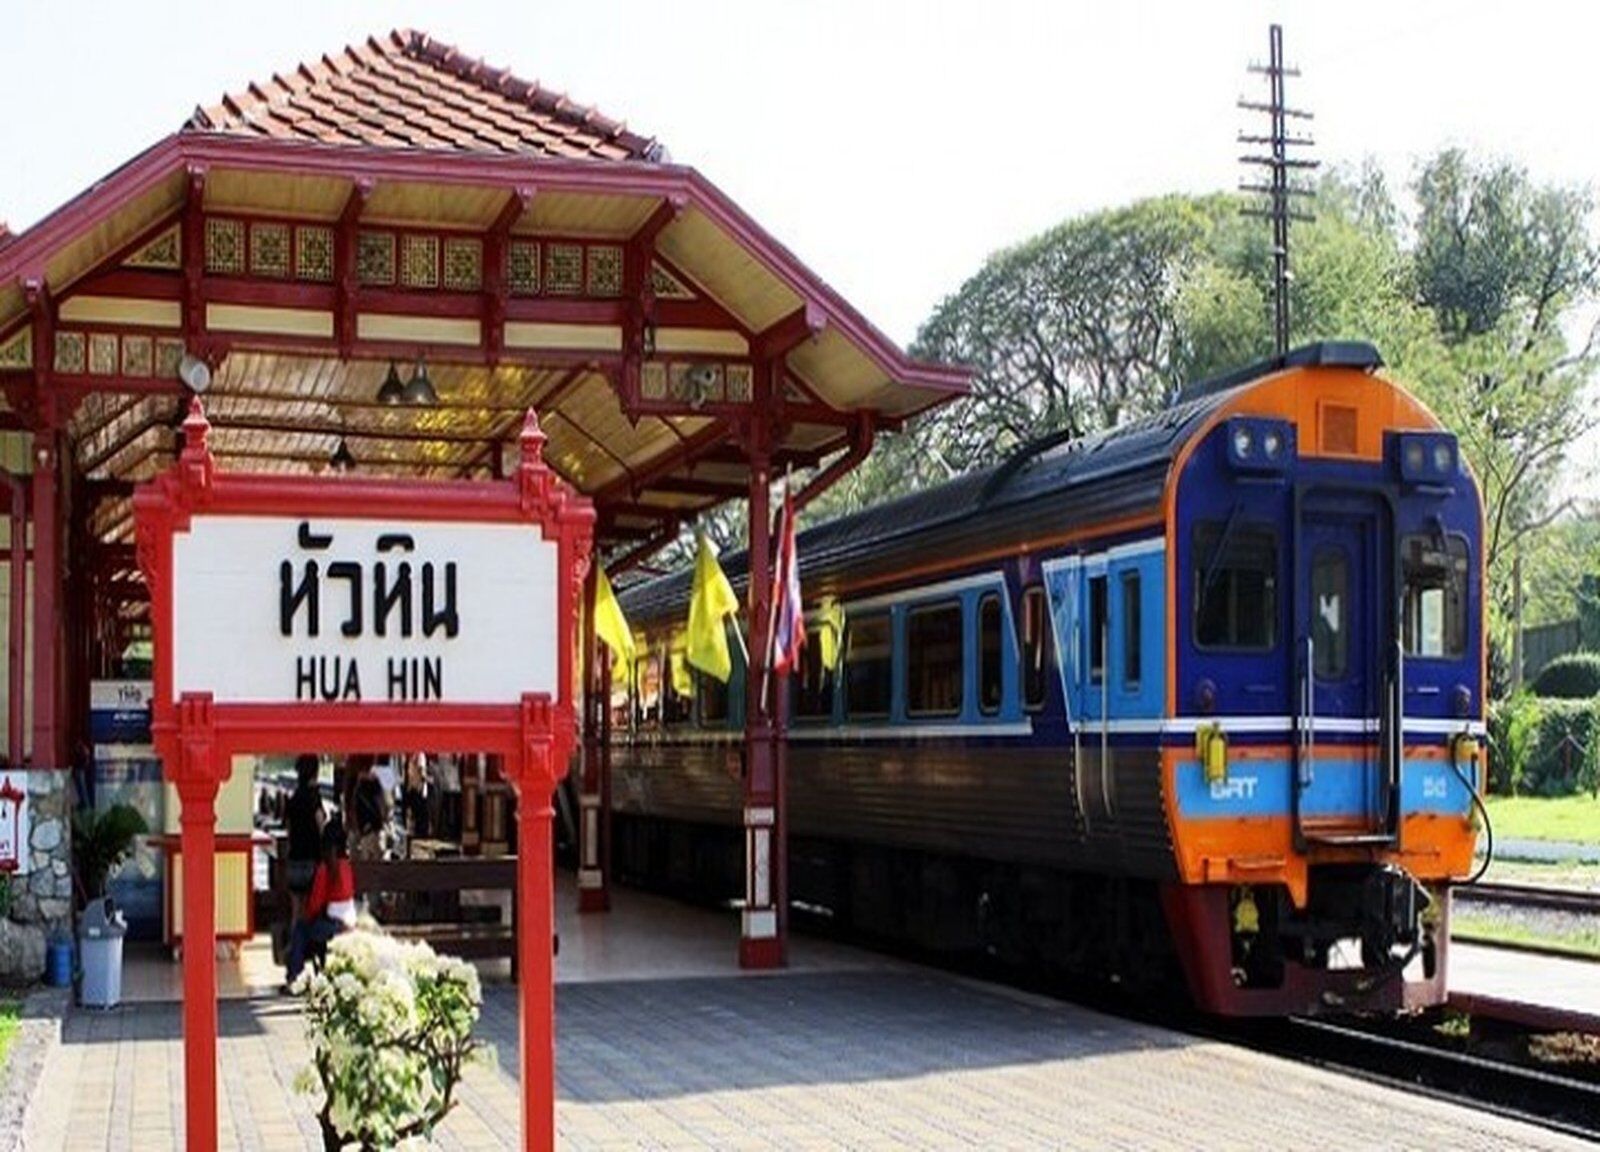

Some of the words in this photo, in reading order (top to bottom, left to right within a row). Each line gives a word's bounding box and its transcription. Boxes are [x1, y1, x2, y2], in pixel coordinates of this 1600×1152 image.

[280, 521, 459, 638] หัวหิน
[296, 656, 361, 701] HUA
[388, 656, 442, 701] HIN
